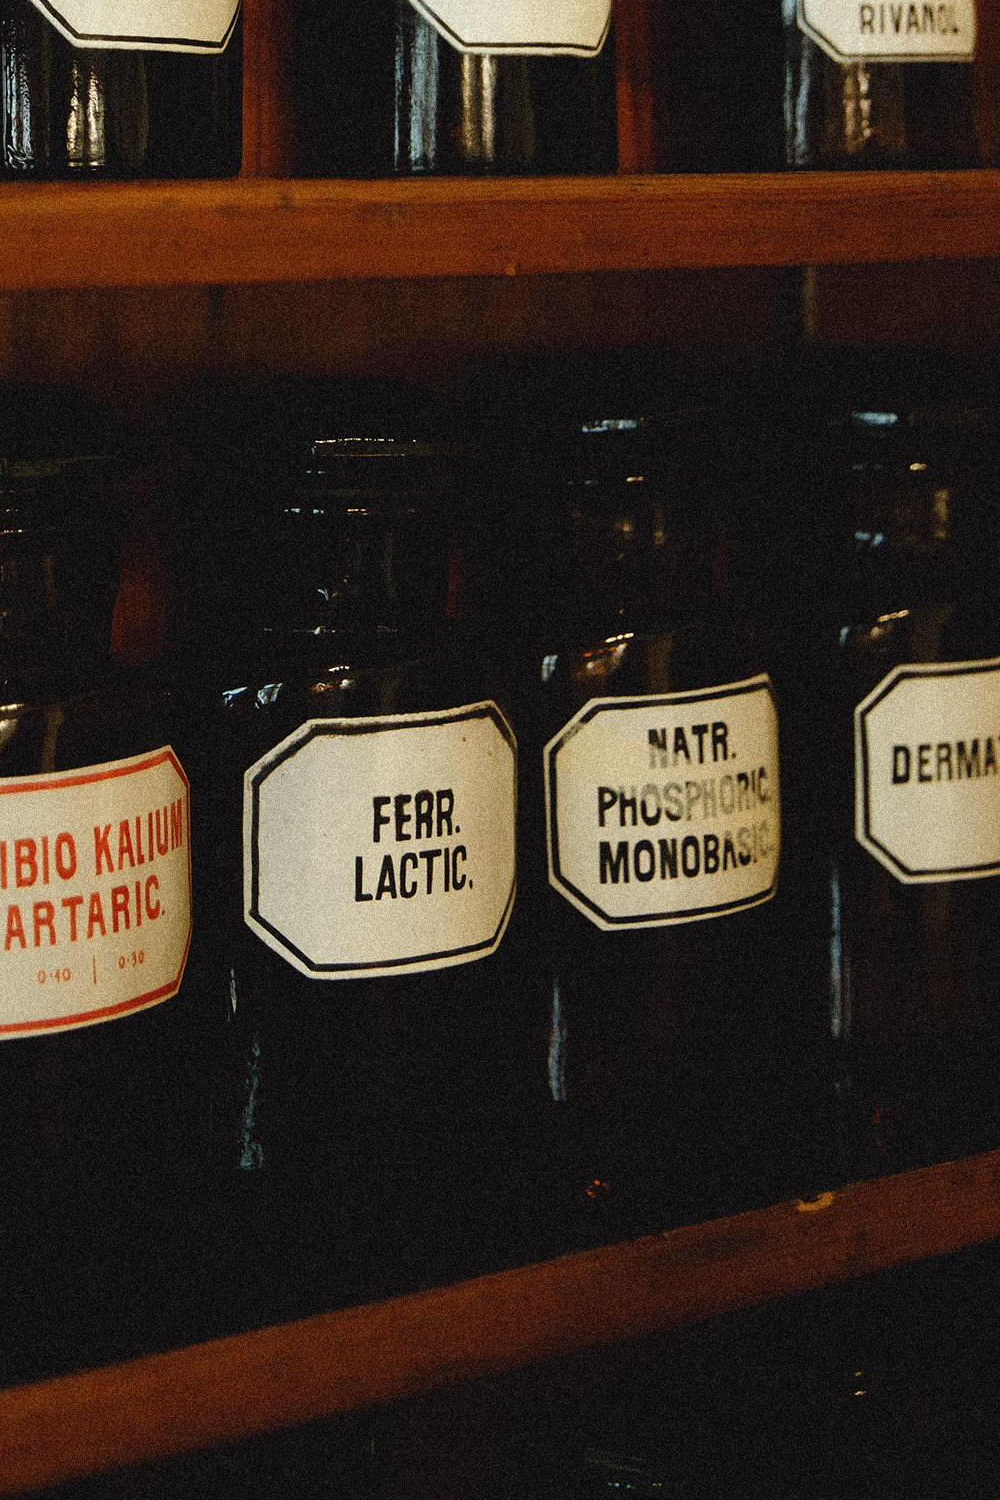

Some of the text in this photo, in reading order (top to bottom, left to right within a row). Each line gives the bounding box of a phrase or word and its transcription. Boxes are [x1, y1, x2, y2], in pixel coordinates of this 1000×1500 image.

[648, 721, 737, 770] NATR.
[93, 797, 184, 876] KALIUM
[372, 788, 461, 844] FERR.
[353, 844, 474, 903] LACTIC.
